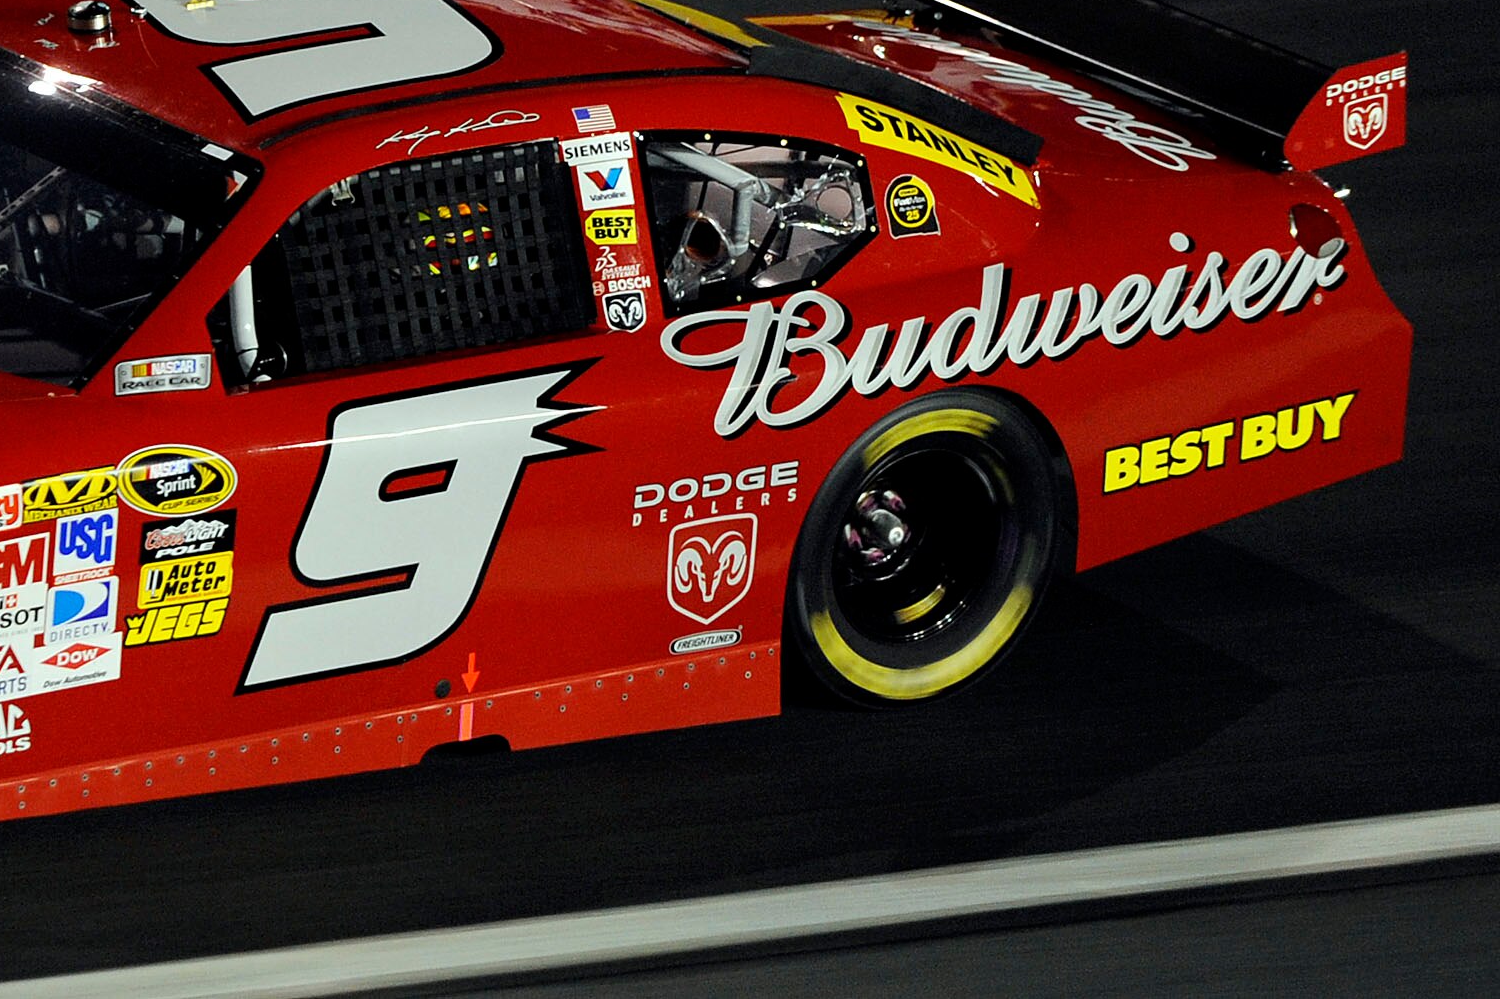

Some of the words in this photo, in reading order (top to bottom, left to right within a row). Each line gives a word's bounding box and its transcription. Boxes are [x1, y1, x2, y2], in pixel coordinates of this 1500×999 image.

[1326, 66, 1407, 98] DODGE
[564, 139, 631, 161] SIEMENS
[854, 103, 1019, 186] STANLEY
[591, 215, 635, 228] BEST
[594, 227, 632, 240] BUY
[608, 276, 652, 293] BOSCH
[659, 232, 1346, 437] Budweiser
[151, 358, 197, 376] NASCAR
[121, 378, 166, 390] RACE
[168, 376, 202, 386] CAR
[1103, 422, 1235, 494] BEST
[1237, 391, 1360, 464] BUY
[155, 473, 197, 498] Sprint
[633, 460, 800, 510] DODGE
[82, 495, 119, 514] WEAR
[631, 488, 798, 527] DEALERS
[241, 361, 598, 693] 9
[58, 512, 114, 565] USG
[155, 541, 216, 559] POLE
[167, 561, 217, 581] Auto
[163, 575, 226, 598] Meter
[49, 621, 110, 643] DIRECTV
[124, 598, 230, 647] JEGS
[676, 633, 736, 651] FREIGHTLINER
[43, 679, 63, 689] Dow
[63, 670, 108, 685] Automotive
